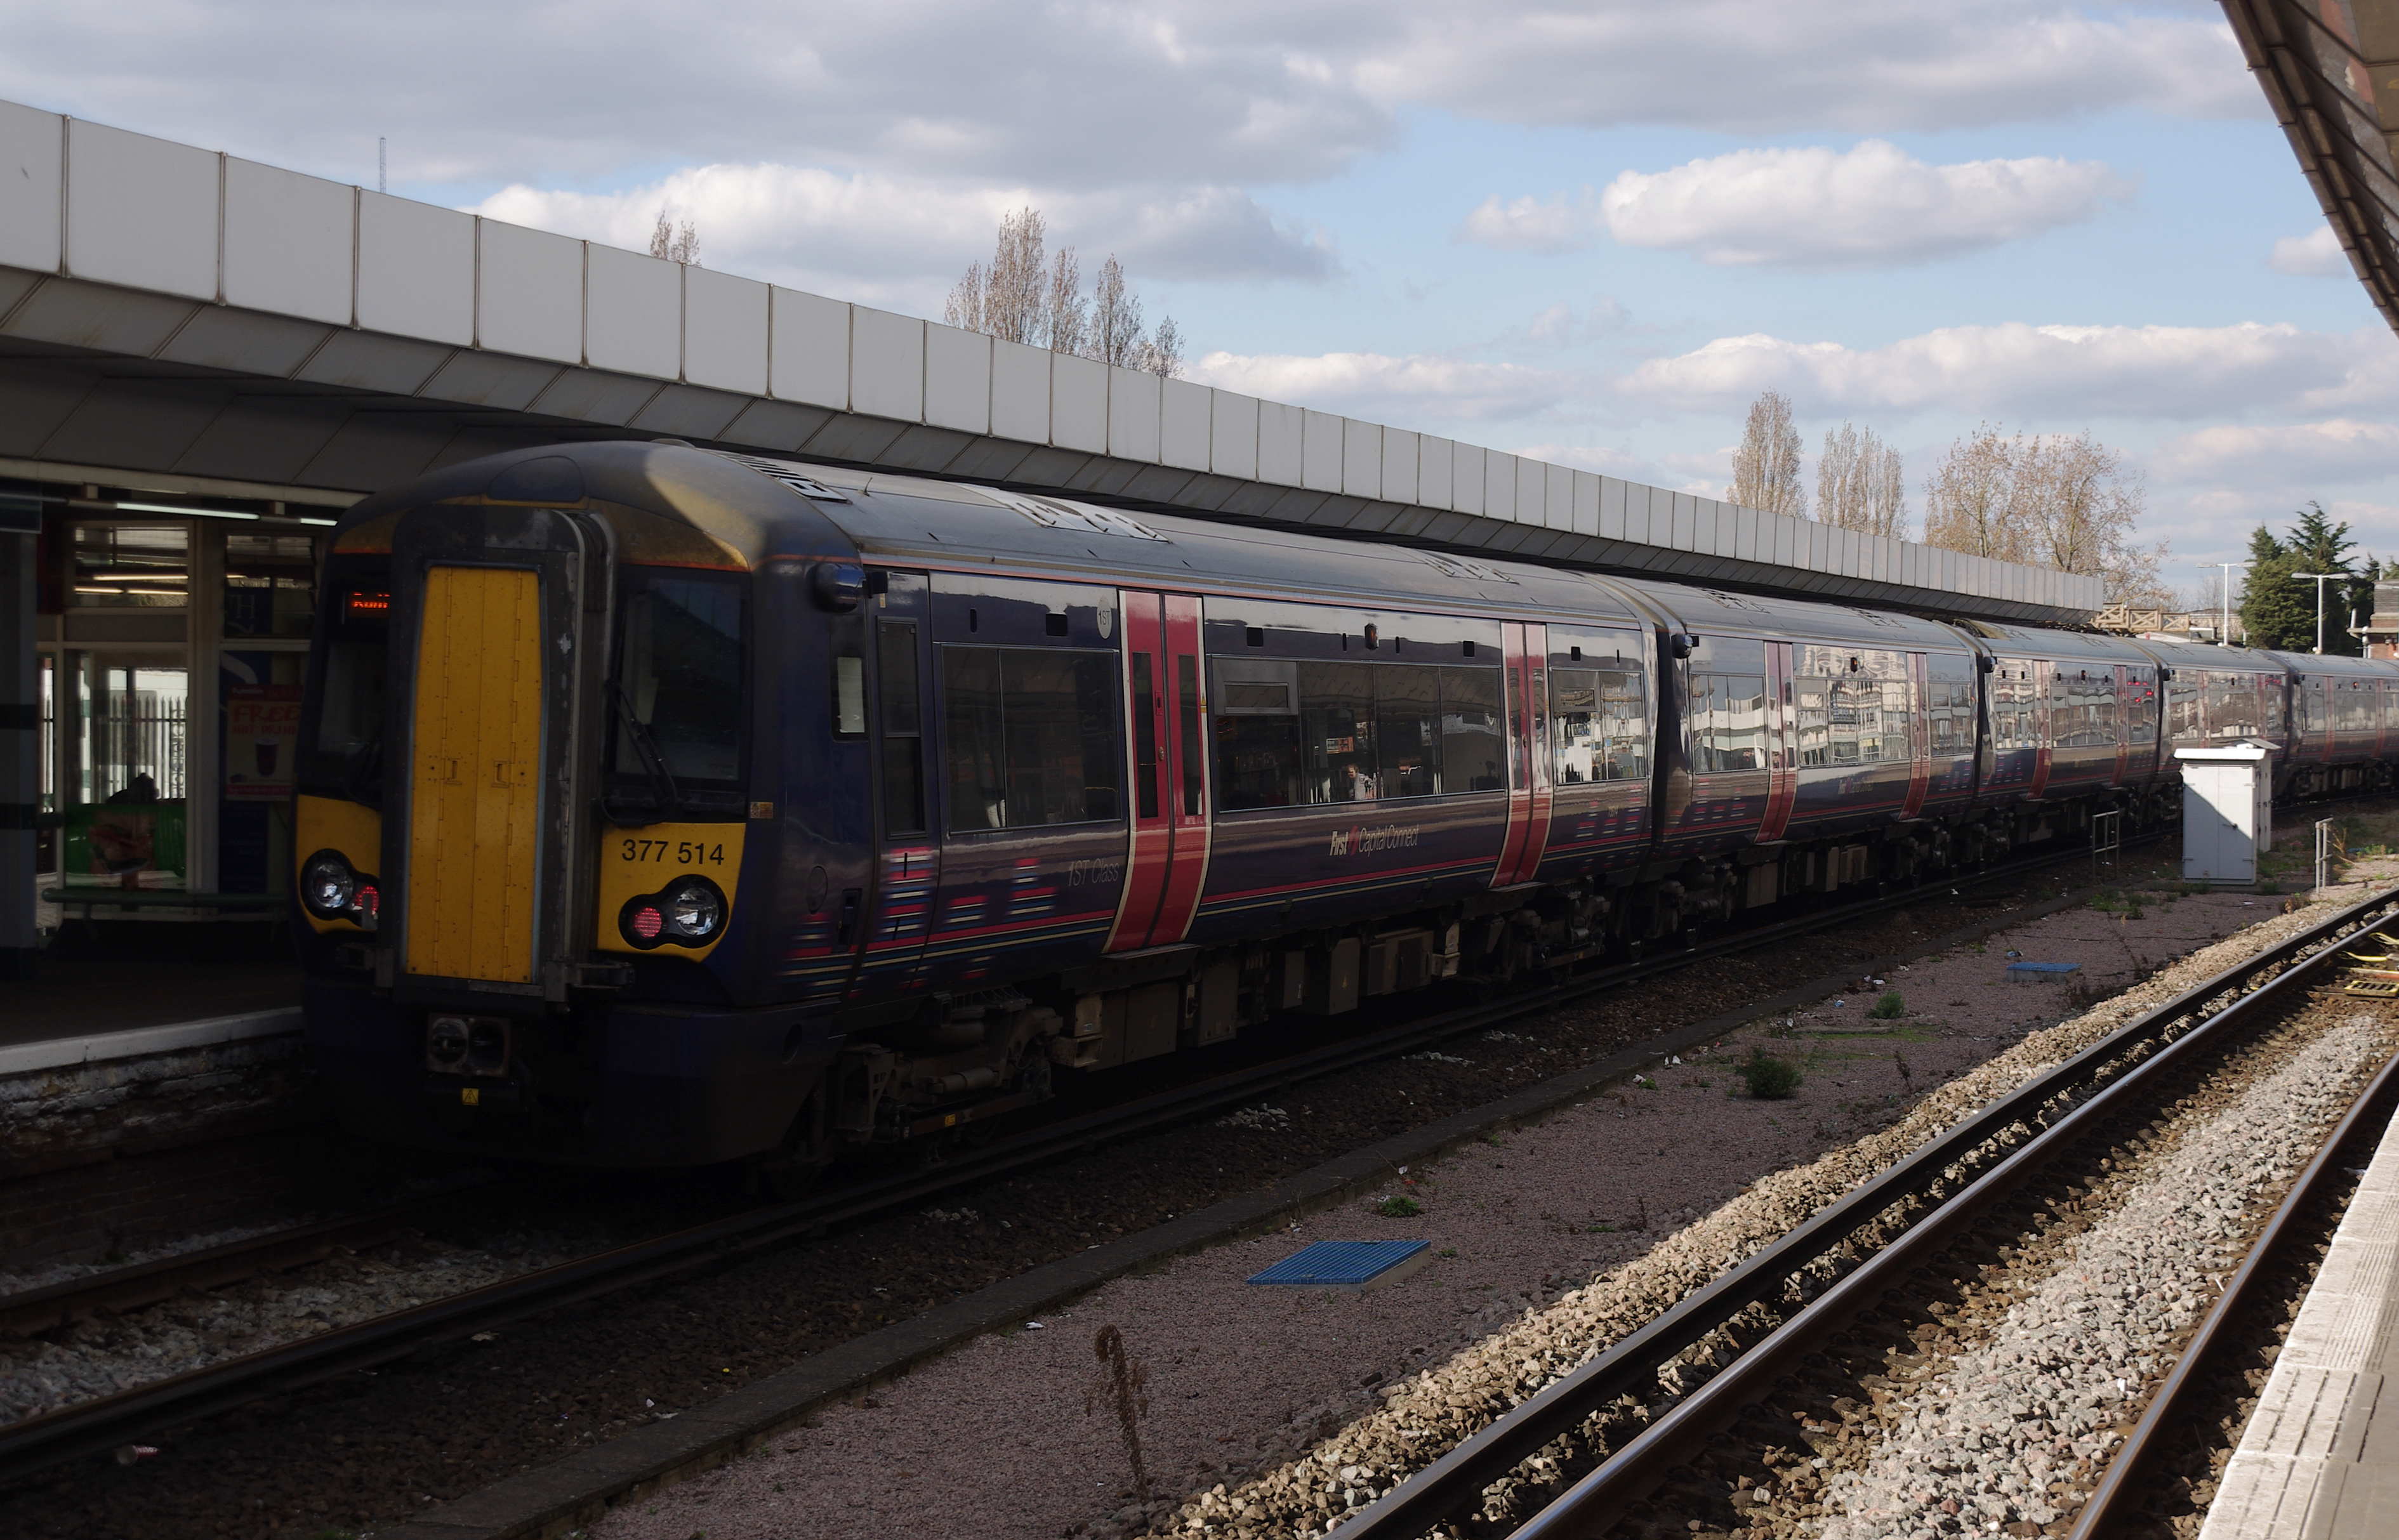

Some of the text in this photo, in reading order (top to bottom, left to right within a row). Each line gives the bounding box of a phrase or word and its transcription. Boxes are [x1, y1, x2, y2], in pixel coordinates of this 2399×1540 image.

[1099, 610, 1110, 625] 1ST
[234, 704, 301, 723] FREE
[232, 725, 256, 735] HOT
[1330, 824, 1419, 857] First Capital Connect
[622, 839, 724, 865] 377 514
[1068, 858, 1120, 886] 1ST Class
